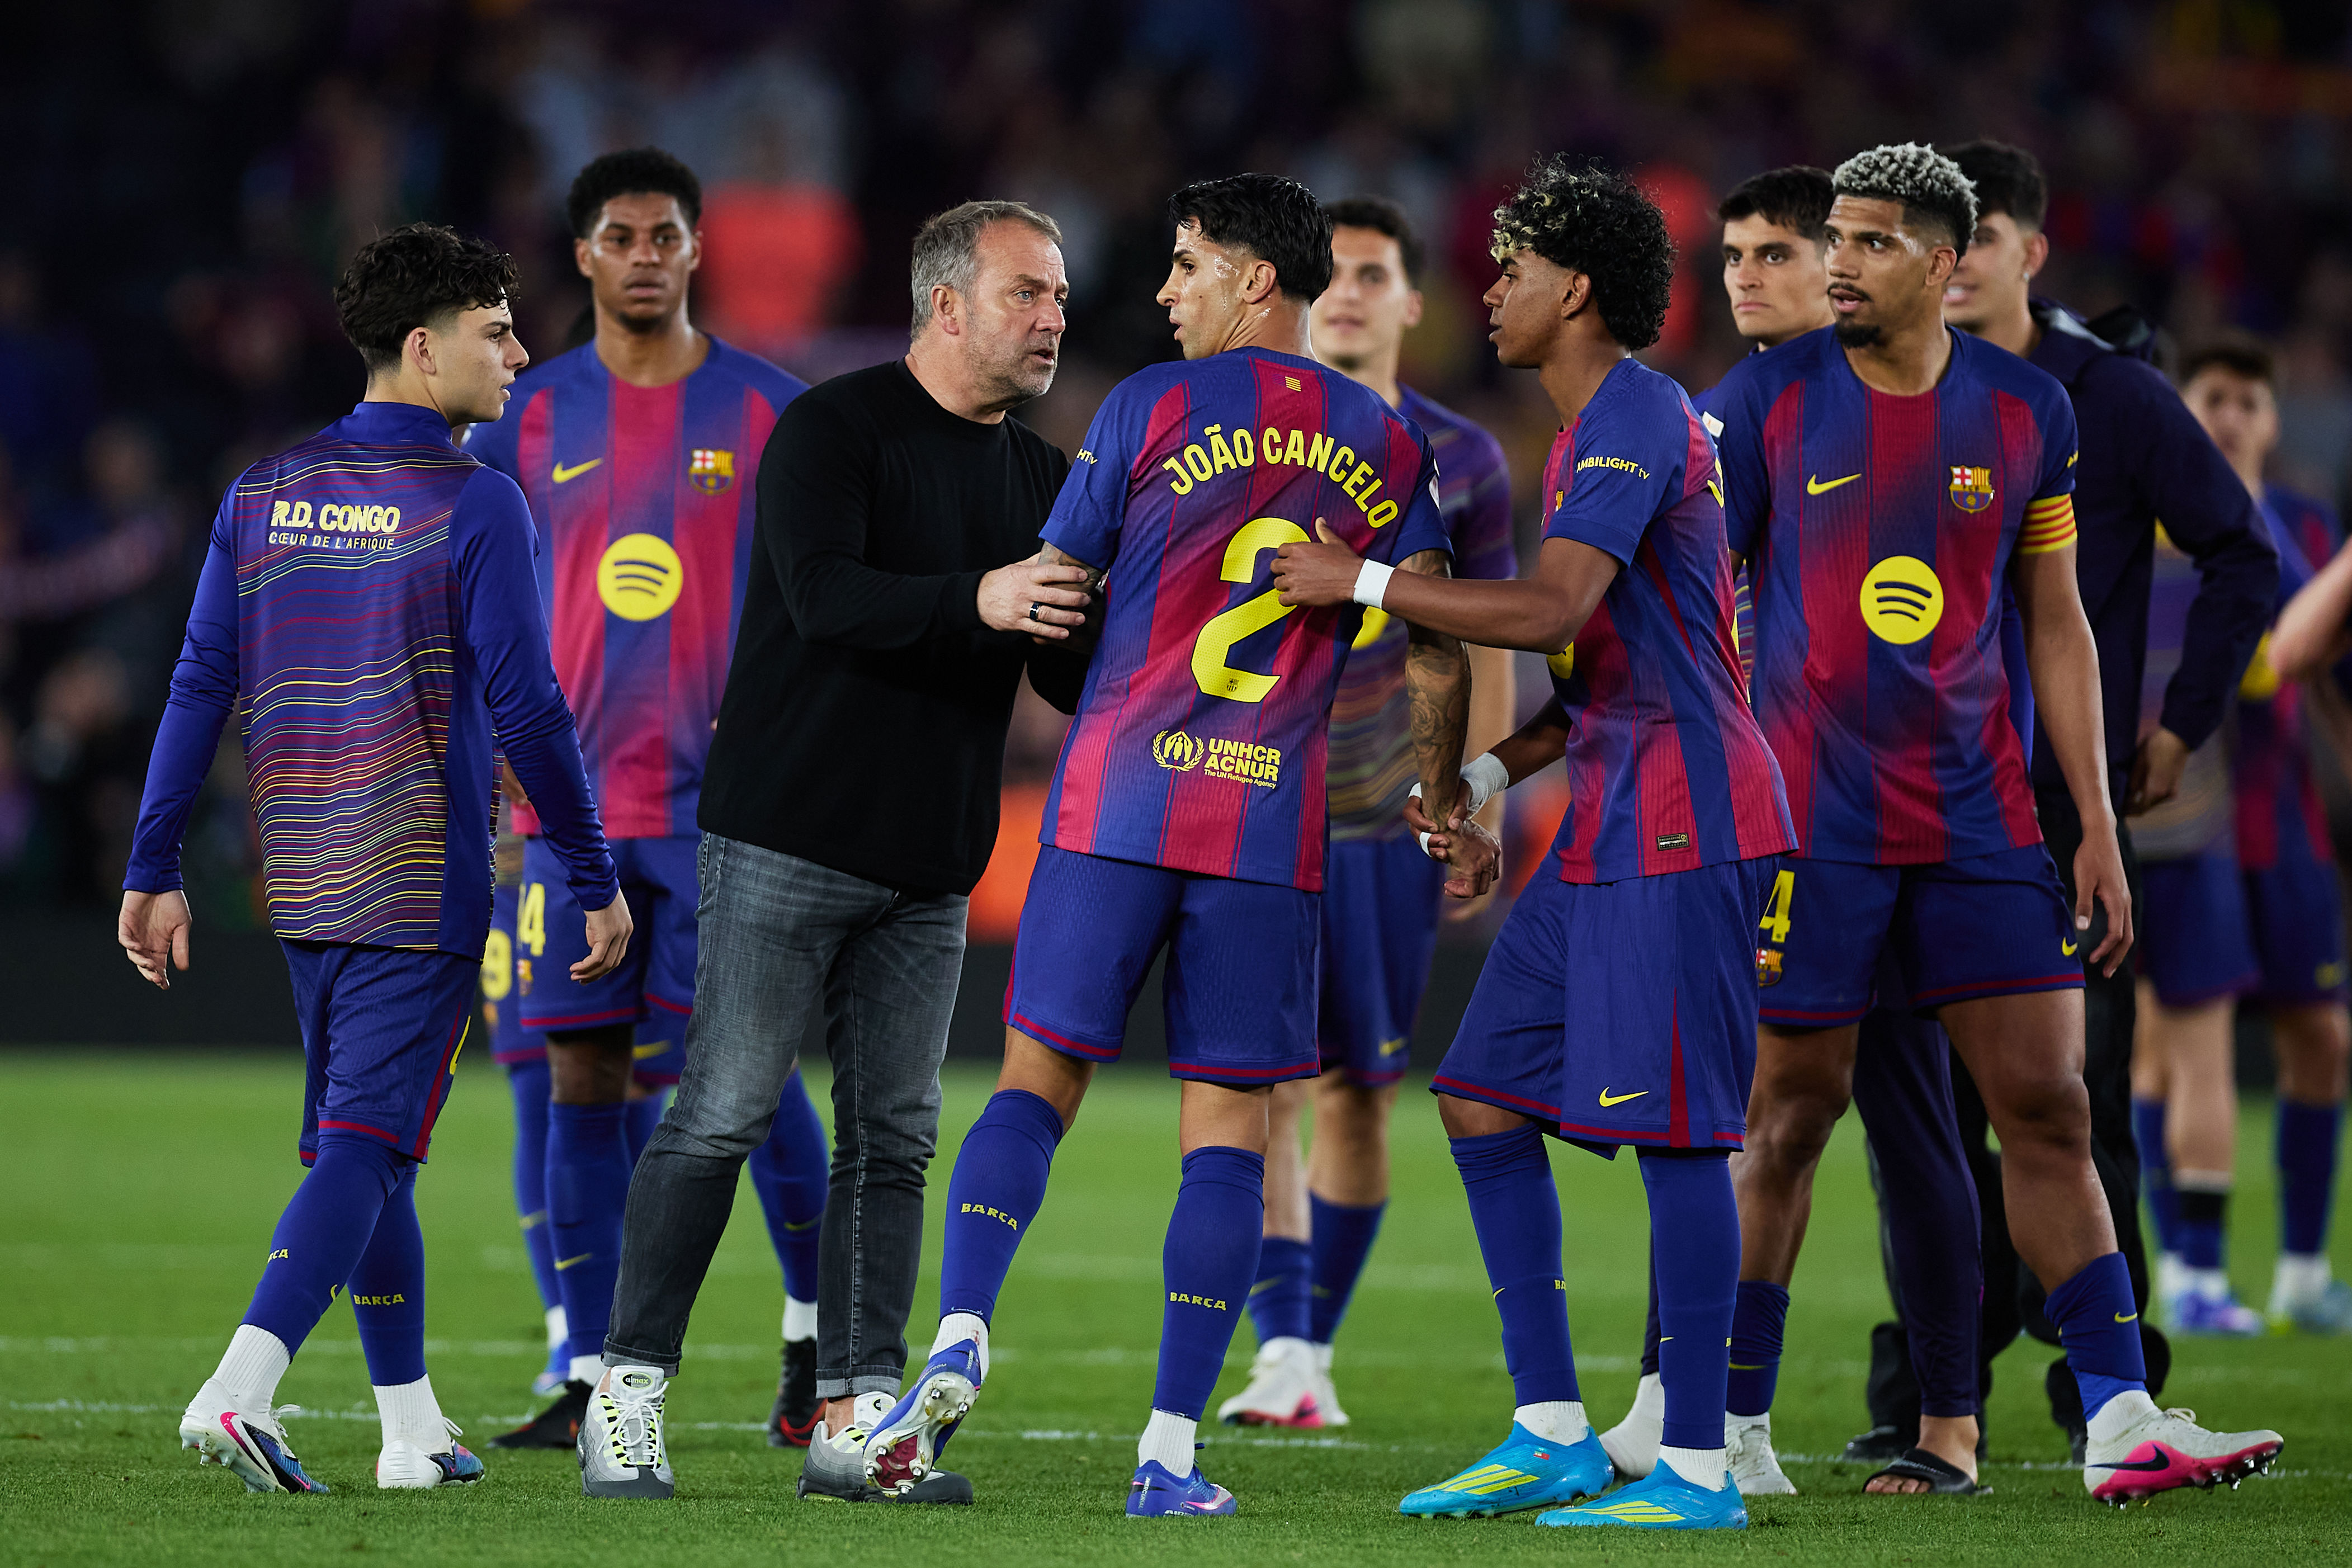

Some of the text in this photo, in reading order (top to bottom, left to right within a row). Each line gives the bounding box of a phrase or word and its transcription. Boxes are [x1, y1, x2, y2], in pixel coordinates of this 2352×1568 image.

[1162, 423, 1398, 528] JOÃO CANCELO
[271, 500, 400, 533] R.D. CONGO
[268, 532, 307, 545] CŒUR
[312, 535, 330, 547] DE
[1191, 517, 1311, 703] 2
[1208, 738, 1281, 766] UNHCR
[1204, 754, 1279, 782] ACNUR
[1204, 768, 1216, 777] The
[1227, 773, 1253, 783] Refugee
[1253, 778, 1276, 789] Agency
[1759, 870, 1795, 943] 4
[353, 1293, 405, 1306] BARÇA
[1170, 1292, 1226, 1311] BARÇA
